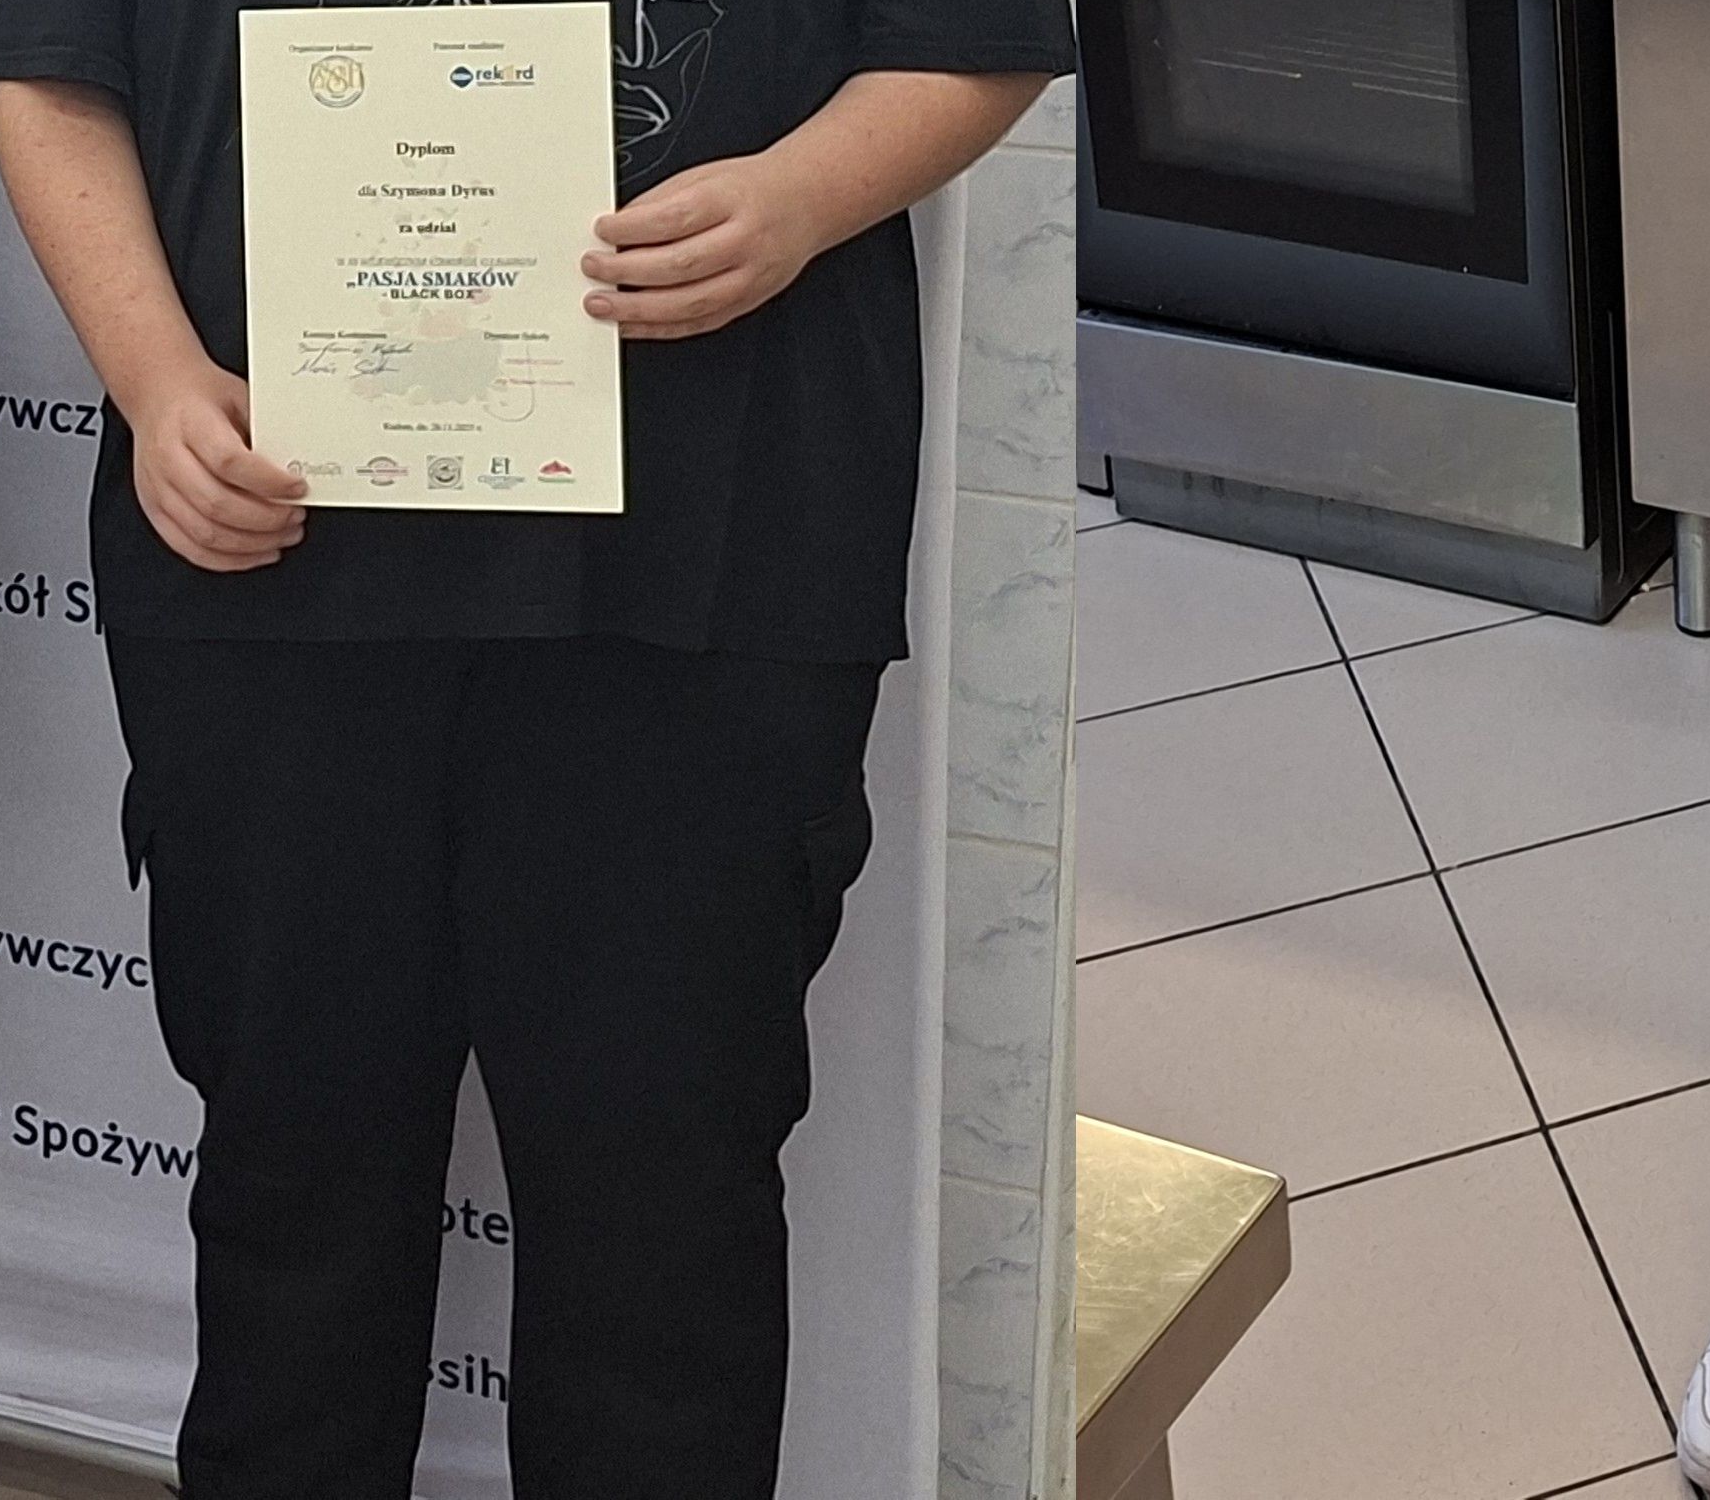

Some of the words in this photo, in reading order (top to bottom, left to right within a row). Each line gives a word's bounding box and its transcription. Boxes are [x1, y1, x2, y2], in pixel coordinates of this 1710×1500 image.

[396, 141, 456, 158] Dyplom
[421, 267, 519, 288] SMAKÓW
[390, 288, 441, 299] BLACK
[13, 1104, 194, 1179] Spożyw
